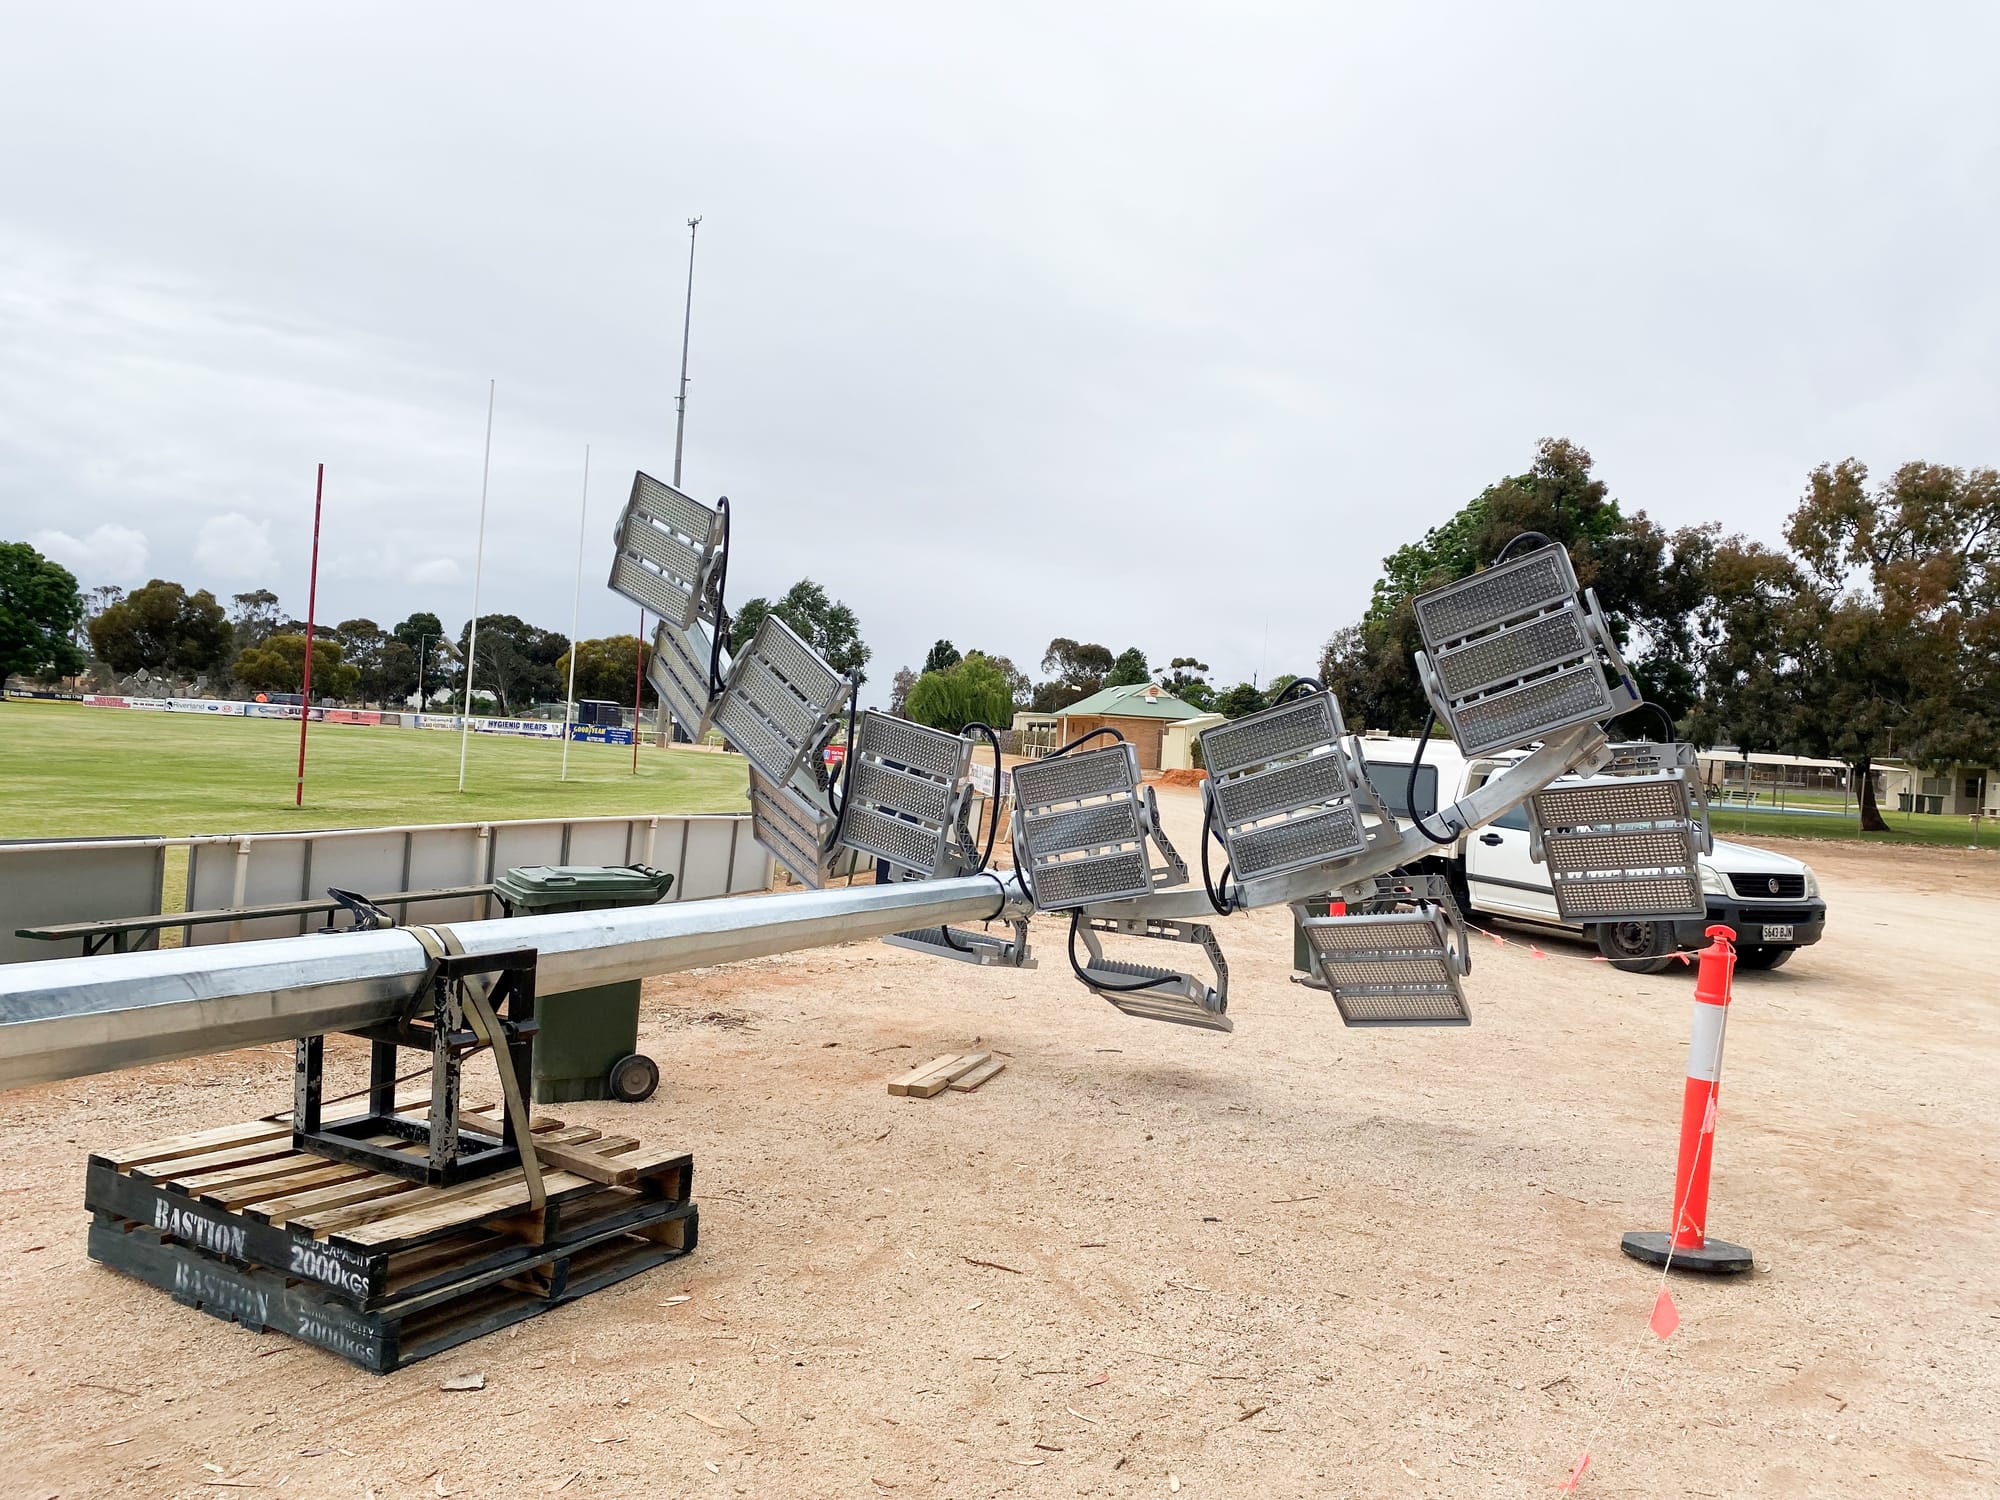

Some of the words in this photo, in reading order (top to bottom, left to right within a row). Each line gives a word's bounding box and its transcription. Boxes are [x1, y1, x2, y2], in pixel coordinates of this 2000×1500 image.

[173, 701, 205, 710] Riverland
[487, 720, 521, 730] HYGIENIC
[523, 722, 548, 731] MEATS
[154, 1197, 247, 1258] BASTION
[289, 1245, 370, 1295] 2000KGS
[297, 1316, 375, 1362] 2000KGS
